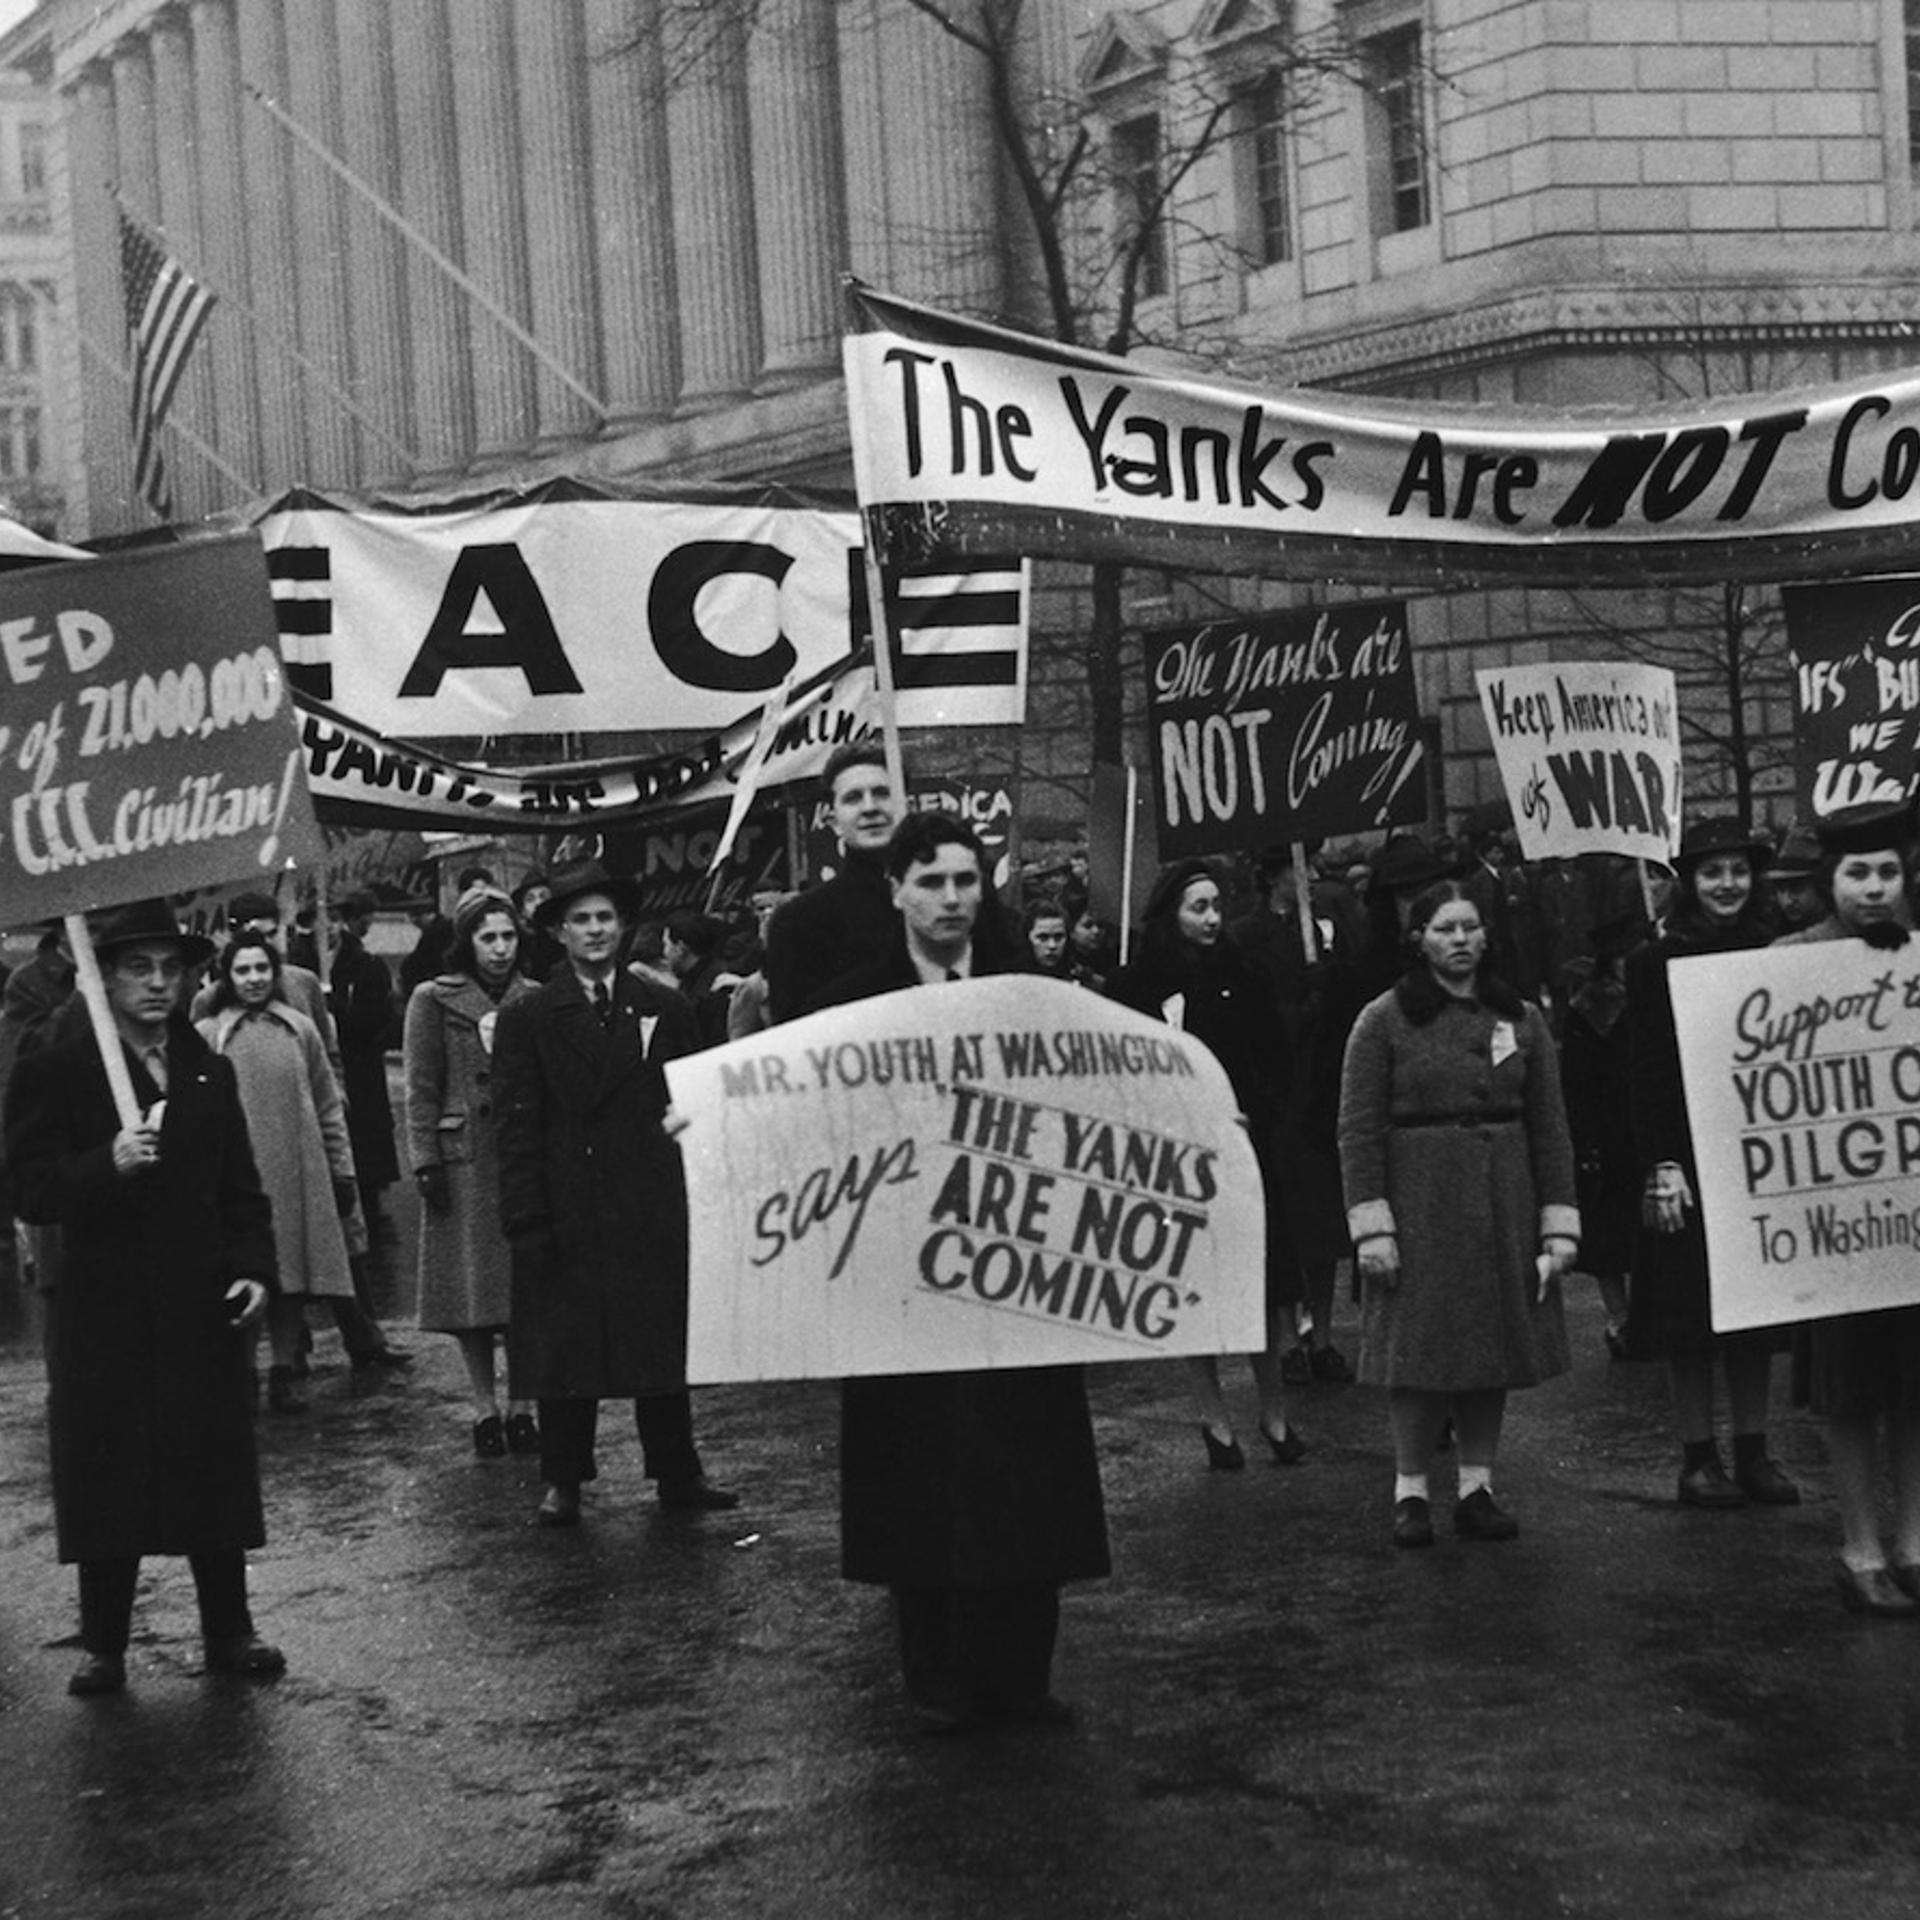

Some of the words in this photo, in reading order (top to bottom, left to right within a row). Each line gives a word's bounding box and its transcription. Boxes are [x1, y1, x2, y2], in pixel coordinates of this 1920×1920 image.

[885, 348, 1037, 482] The
[1059, 376, 1335, 512] Yanks
[1388, 431, 1539, 525] Are
[1552, 409, 1810, 529] NOT
[1828, 395, 1920, 510] Co
[0, 609, 114, 684] ED
[1223, 612, 1343, 714] Yanks
[1350, 617, 1402, 680] are
[18, 701, 65, 799] of
[1489, 679, 1556, 746] Keep
[1556, 675, 1650, 737] America
[1850, 718, 1905, 753] WE
[1160, 708, 1273, 827] NOT
[1288, 691, 1424, 826] Coming!
[1733, 970, 1895, 1062] Support
[719, 1054, 806, 1099] MR.
[807, 1036, 938, 1088] YOUTH
[950, 1034, 986, 1081] AT
[995, 1030, 1196, 1081] WASHINGTON
[1733, 1054, 1874, 1124] YOUTH
[1062, 1111, 1220, 1203] YANKS
[928, 1154, 1056, 1245] ARE
[1070, 1191, 1209, 1278] NOT
[1752, 1214, 1797, 1265] To
